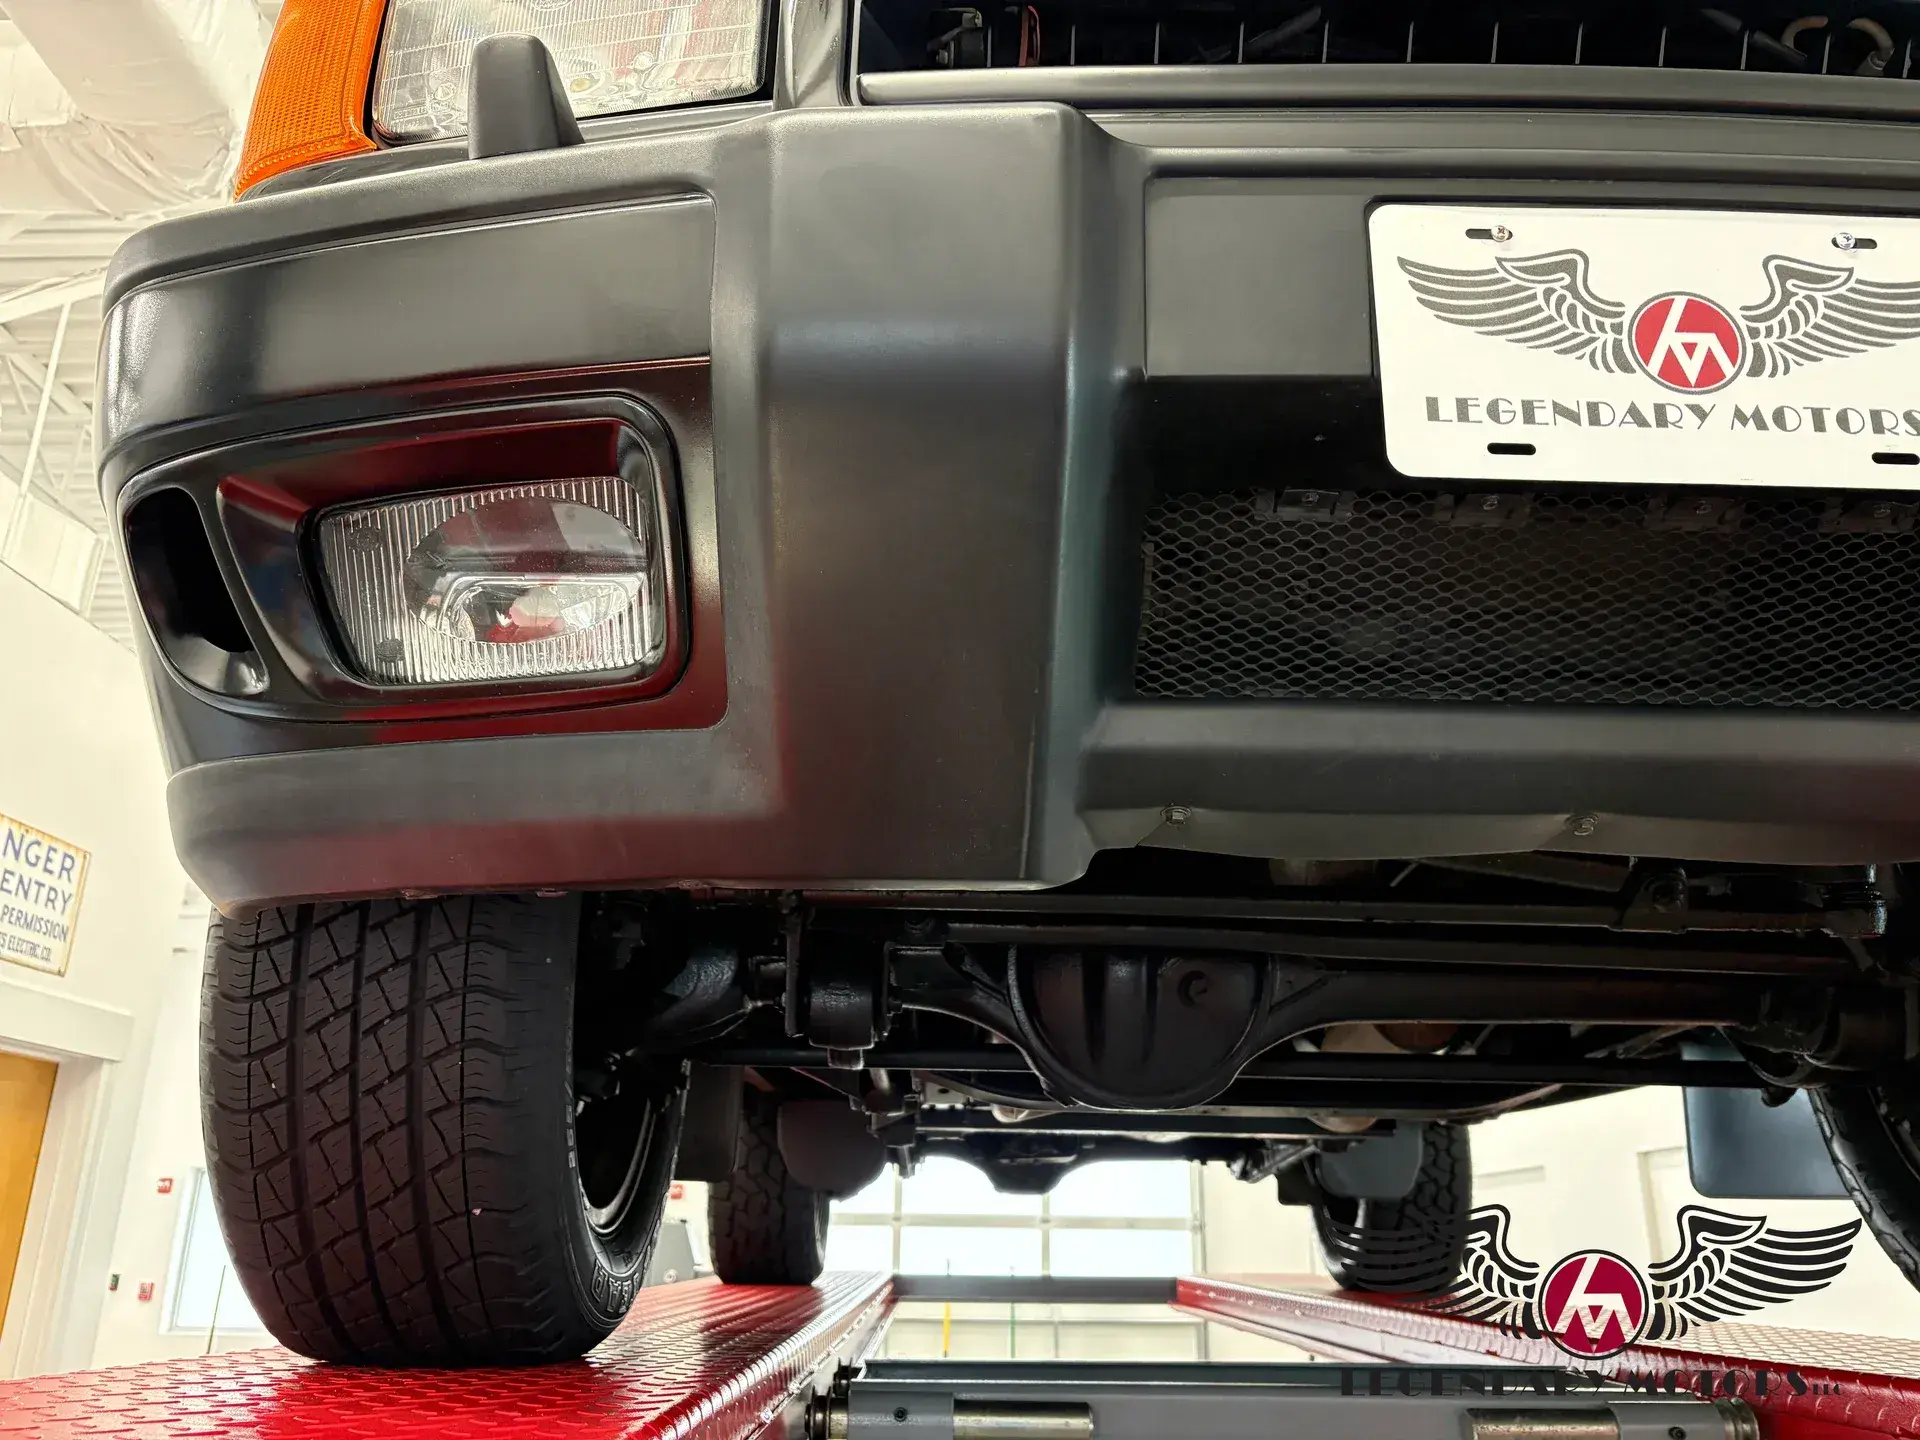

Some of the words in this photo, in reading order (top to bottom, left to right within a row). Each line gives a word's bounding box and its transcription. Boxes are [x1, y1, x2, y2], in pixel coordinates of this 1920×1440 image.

[1425, 396, 1716, 431] LEGENDARY
[1730, 403, 1920, 437] MOTORS
[2, 828, 76, 883] NGER
[0, 868, 73, 915] ENTRY
[0, 904, 69, 942] PERMISSION
